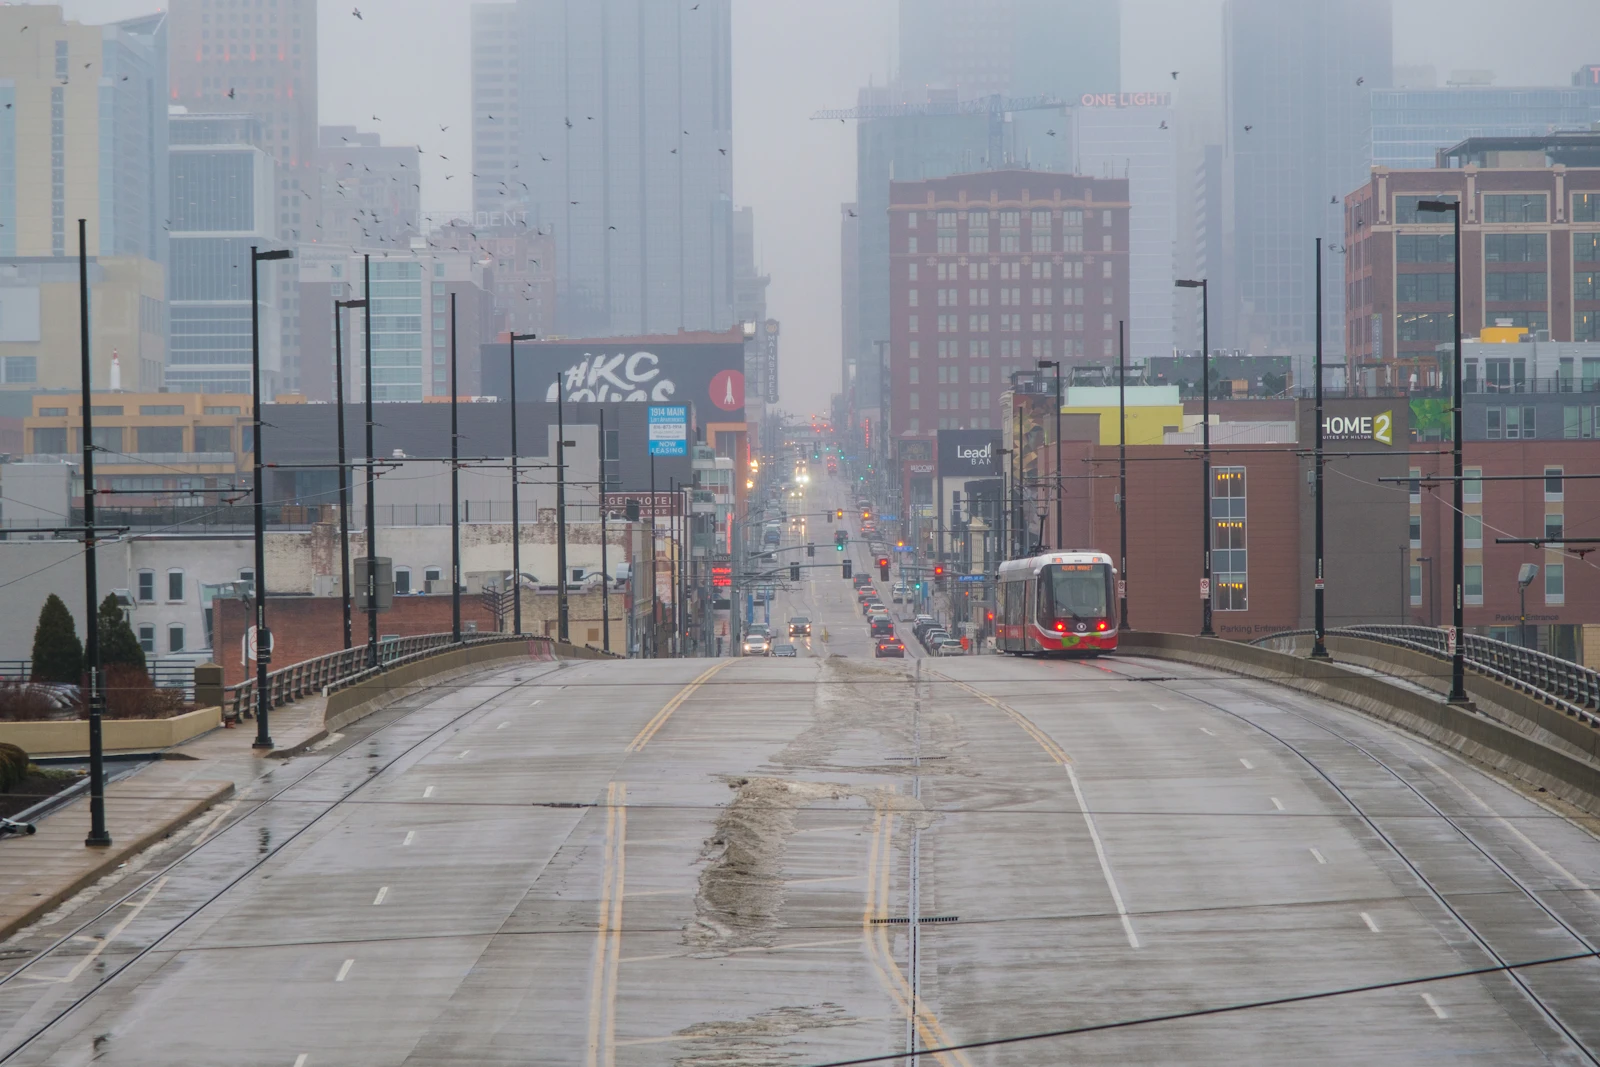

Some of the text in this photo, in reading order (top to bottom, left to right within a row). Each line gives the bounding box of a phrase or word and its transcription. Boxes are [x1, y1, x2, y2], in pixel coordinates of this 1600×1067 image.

[1082, 93, 1168, 106] ONE LIGHT
[416, 211, 529, 227] PSIDENT
[565, 352, 659, 391] #KC
[650, 408, 685, 416] 1914 MAIN
[1322, 416, 1372, 434] HOME
[1221, 625, 1292, 635] Parking Entrance
